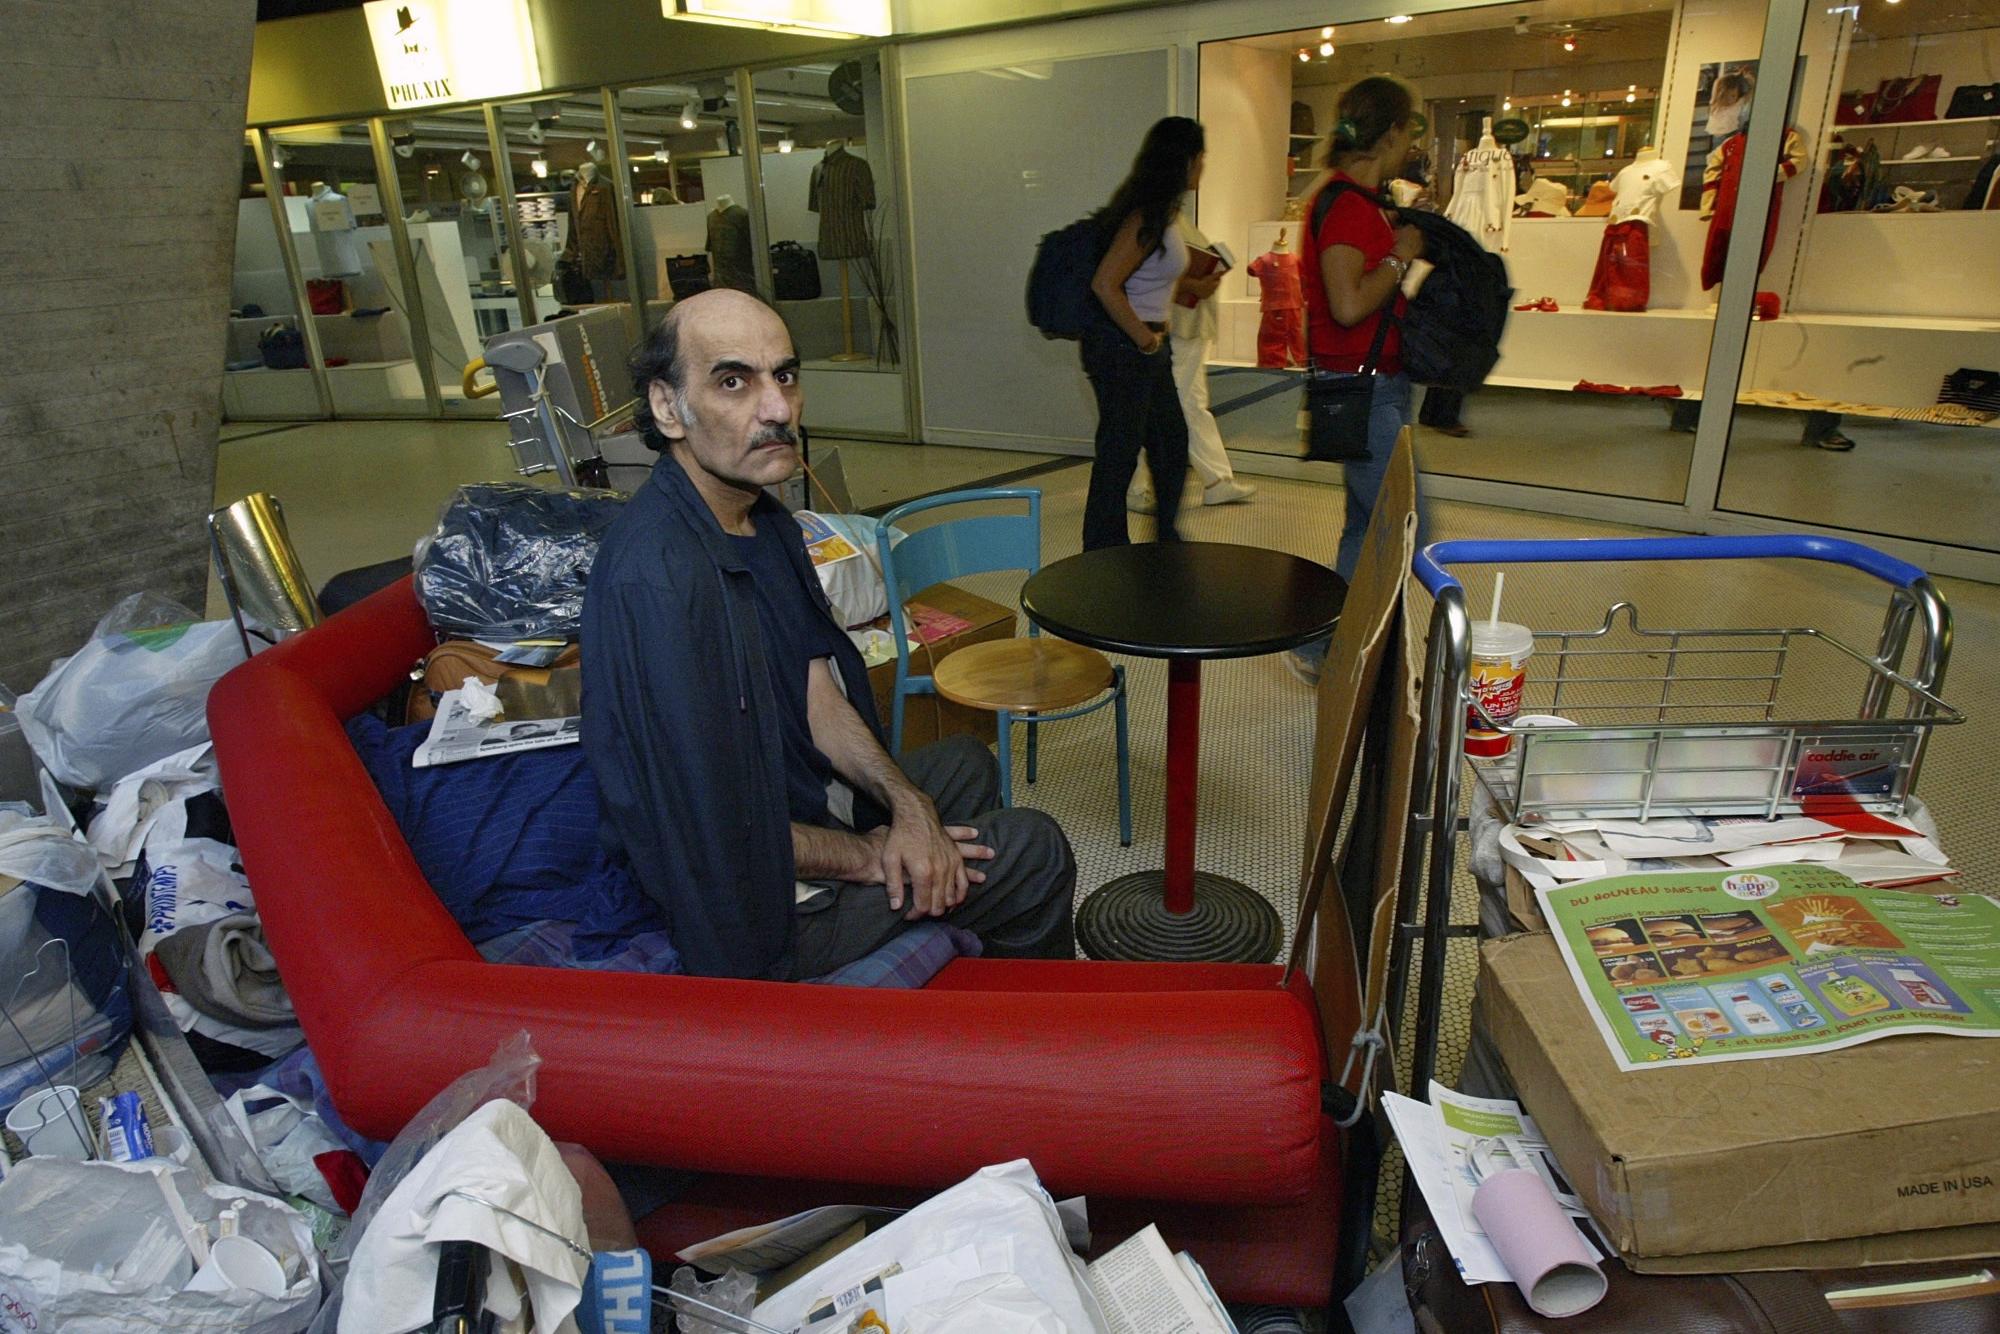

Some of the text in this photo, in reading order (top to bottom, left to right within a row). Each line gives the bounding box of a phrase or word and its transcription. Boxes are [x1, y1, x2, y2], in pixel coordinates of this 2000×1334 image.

[1807, 749, 1880, 762] caddie air
[150, 864, 178, 920] PRINTEMPS
[1727, 880, 1774, 893] happy
[1569, 896, 1590, 908] DU
[1875, 1012, 1906, 1023] pour
[1897, 1175, 1993, 1198] MADE IN USA
